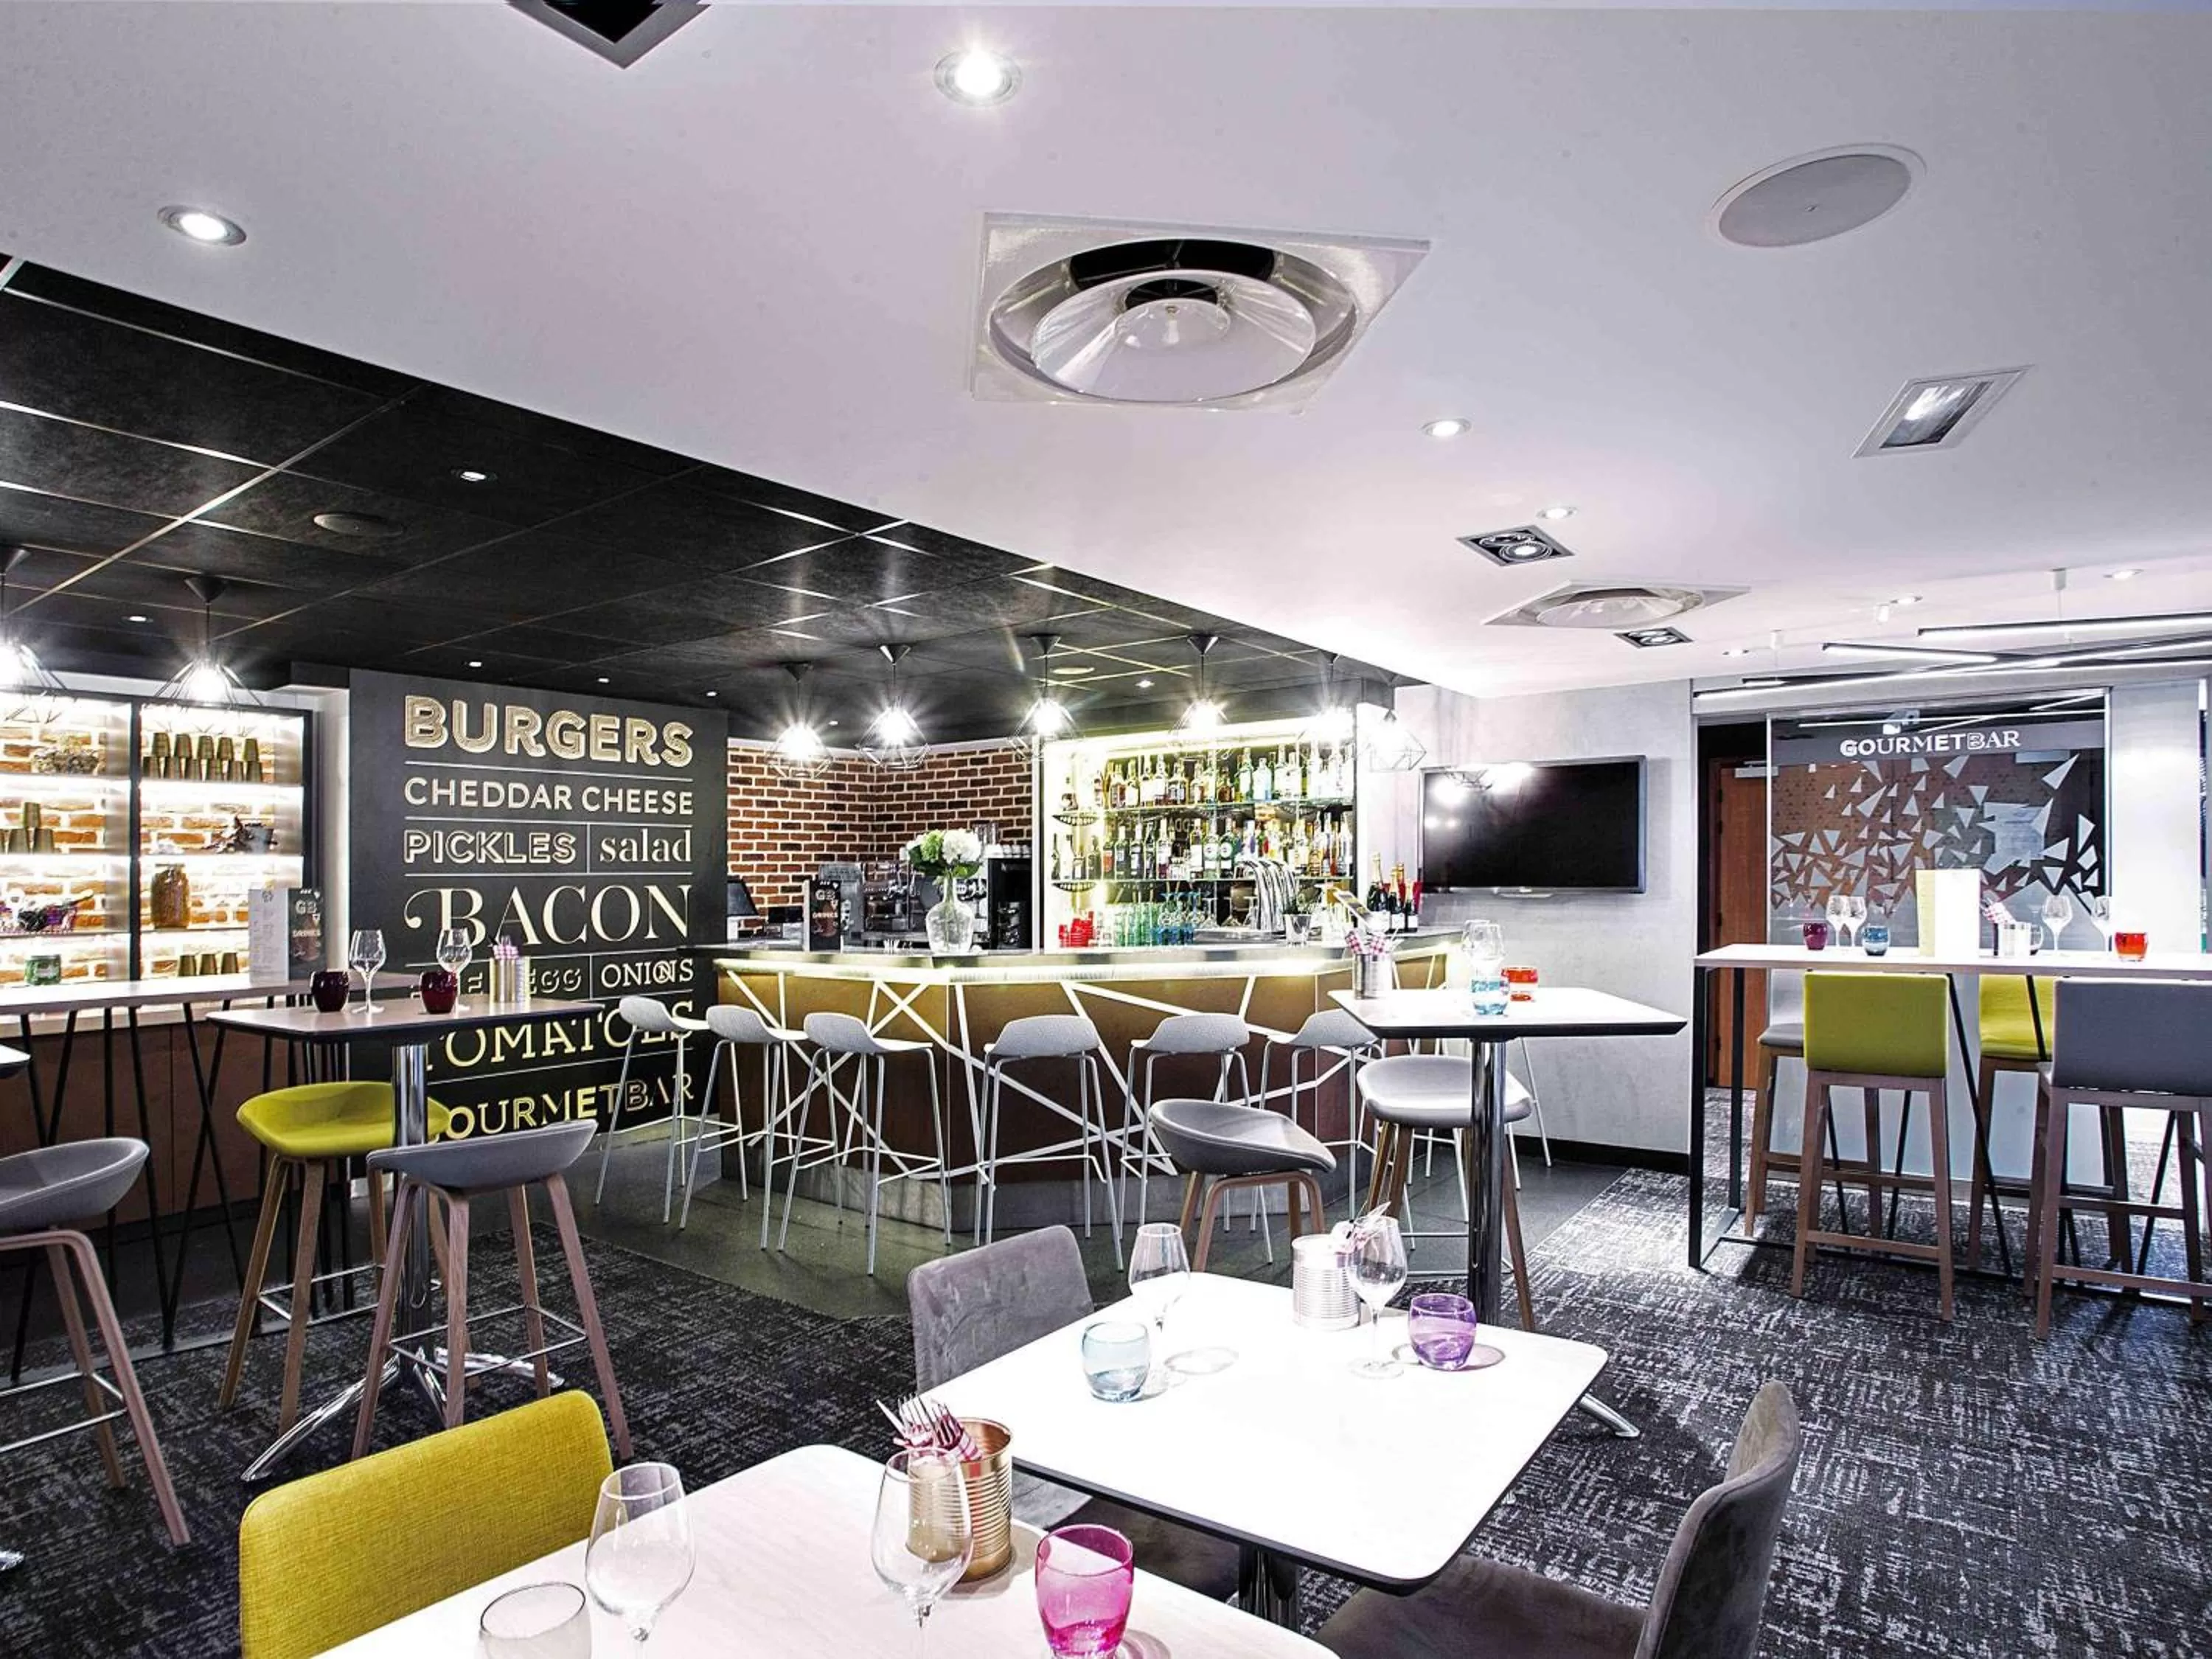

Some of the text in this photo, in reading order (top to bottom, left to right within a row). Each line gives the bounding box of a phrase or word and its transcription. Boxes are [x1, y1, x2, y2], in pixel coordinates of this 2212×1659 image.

[404, 695, 694, 768] BURGERS
[1840, 730, 2021, 757] GOURMETBAR
[404, 777, 693, 815] CHEDDAR CHEESE
[403, 828, 692, 864] PICKLES salad
[403, 885, 692, 947] BACON
[601, 959, 693, 988] ONIONS
[426, 1001, 693, 1071] OMATOS
[431, 1073, 694, 1144] OURMETBAR
